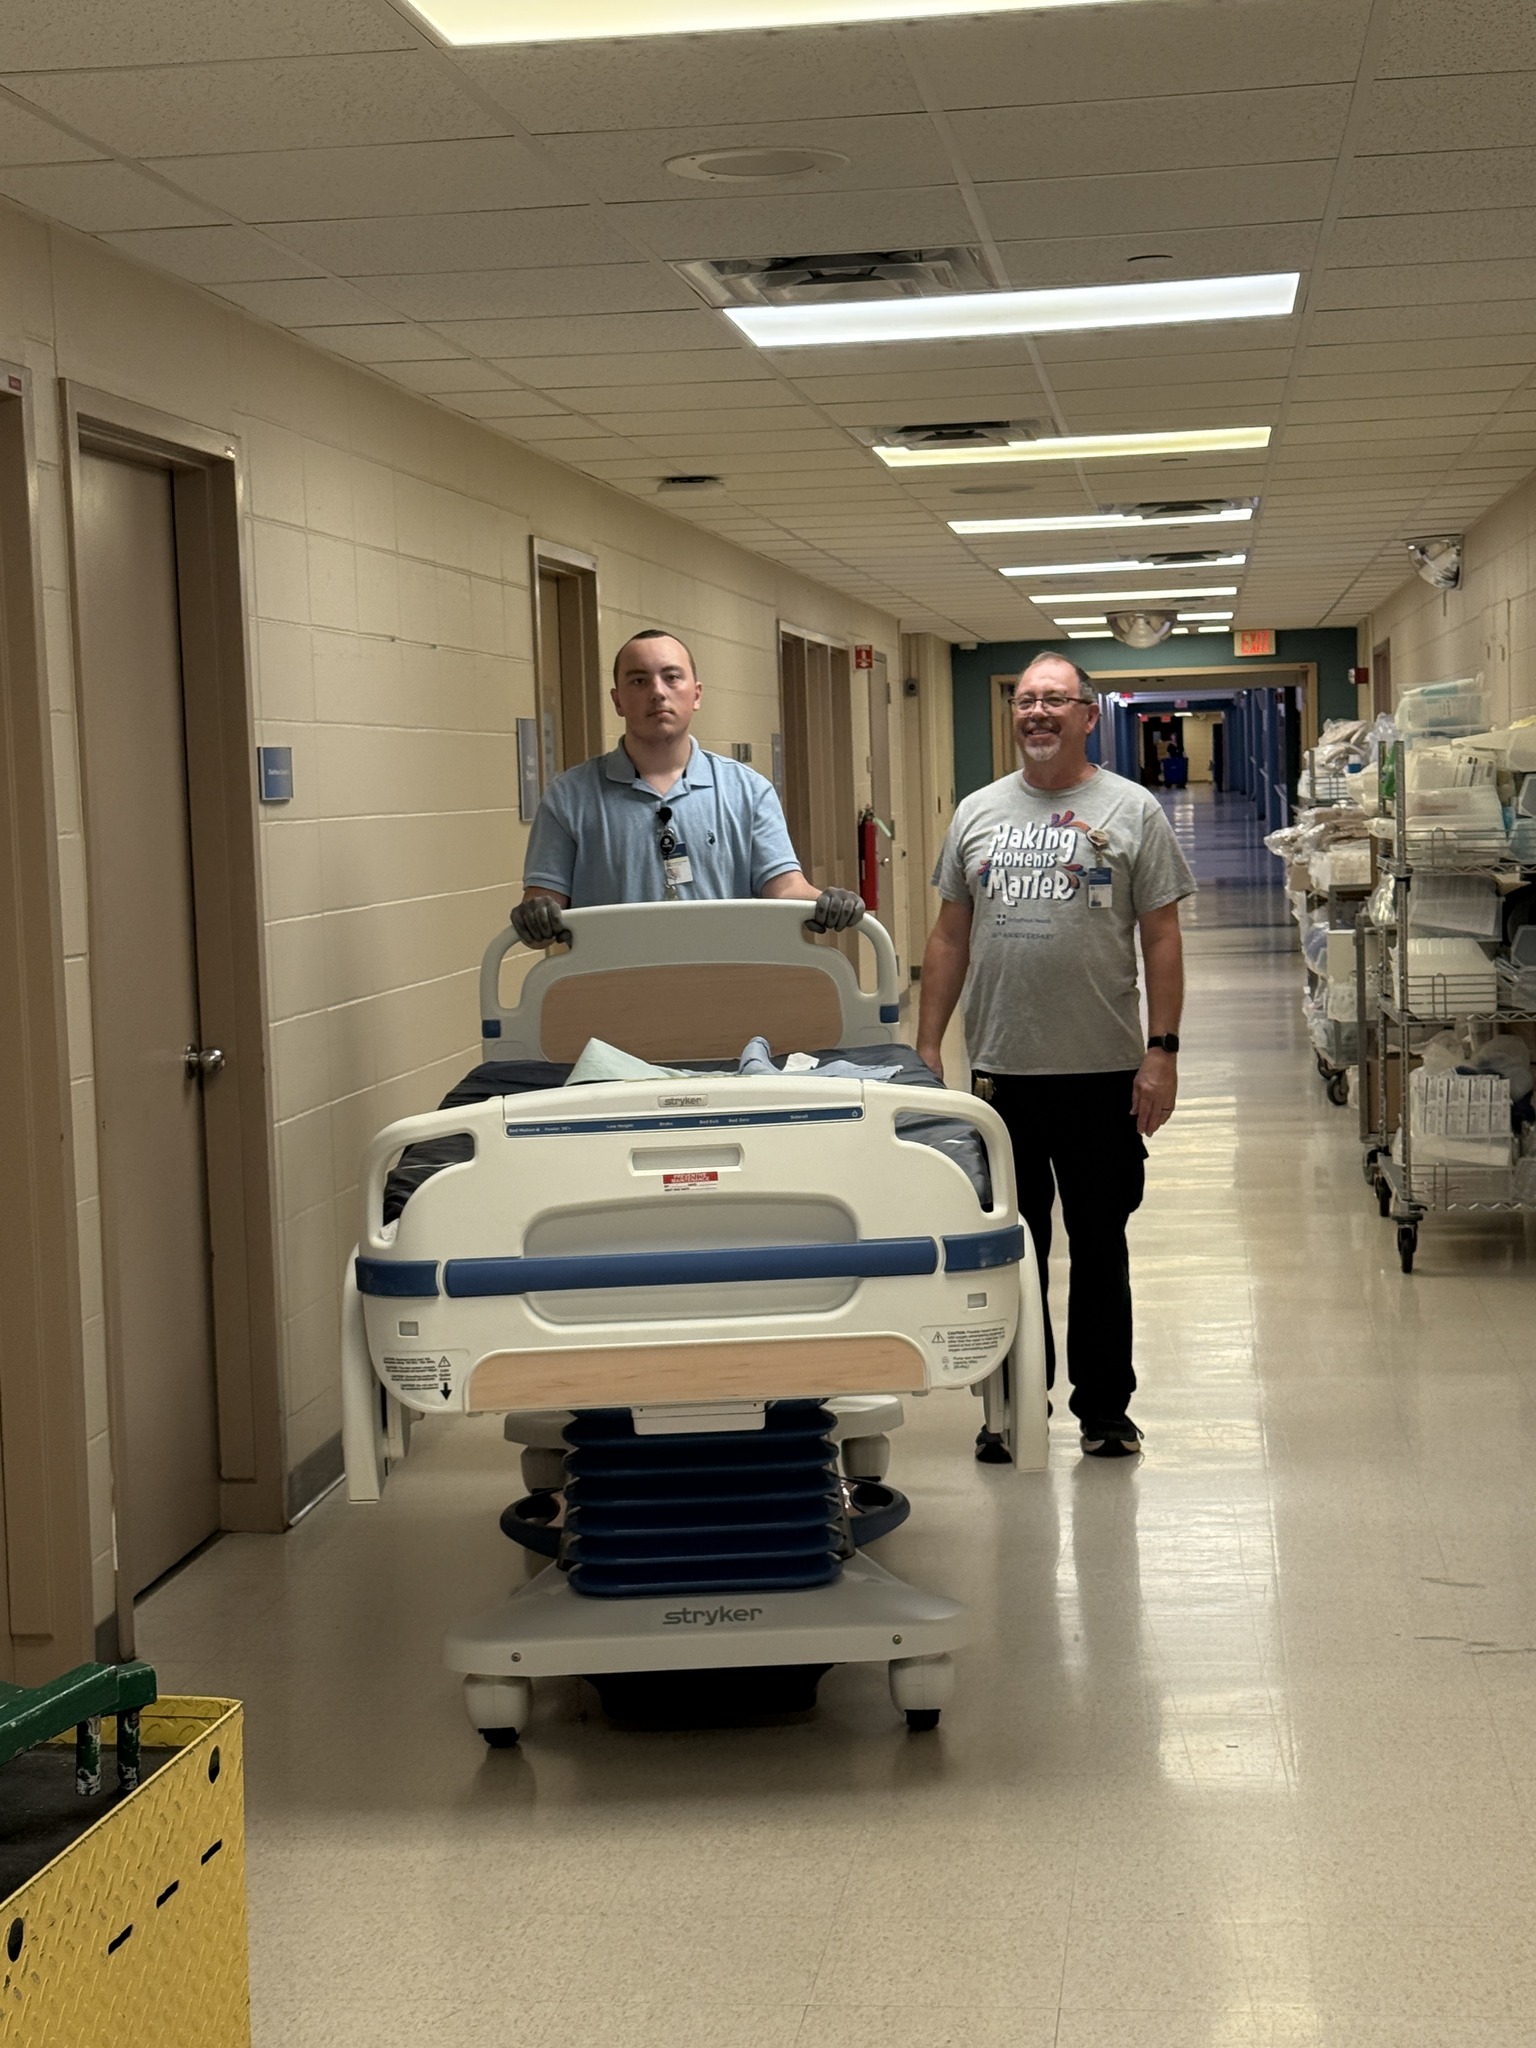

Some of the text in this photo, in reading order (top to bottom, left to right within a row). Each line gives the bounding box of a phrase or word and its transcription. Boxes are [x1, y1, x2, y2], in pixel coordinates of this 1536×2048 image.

[1241, 630, 1269, 654] EXIT
[987, 822, 1077, 863] Making
[664, 1097, 702, 1106] stryker
[662, 1605, 763, 1626] stryker
